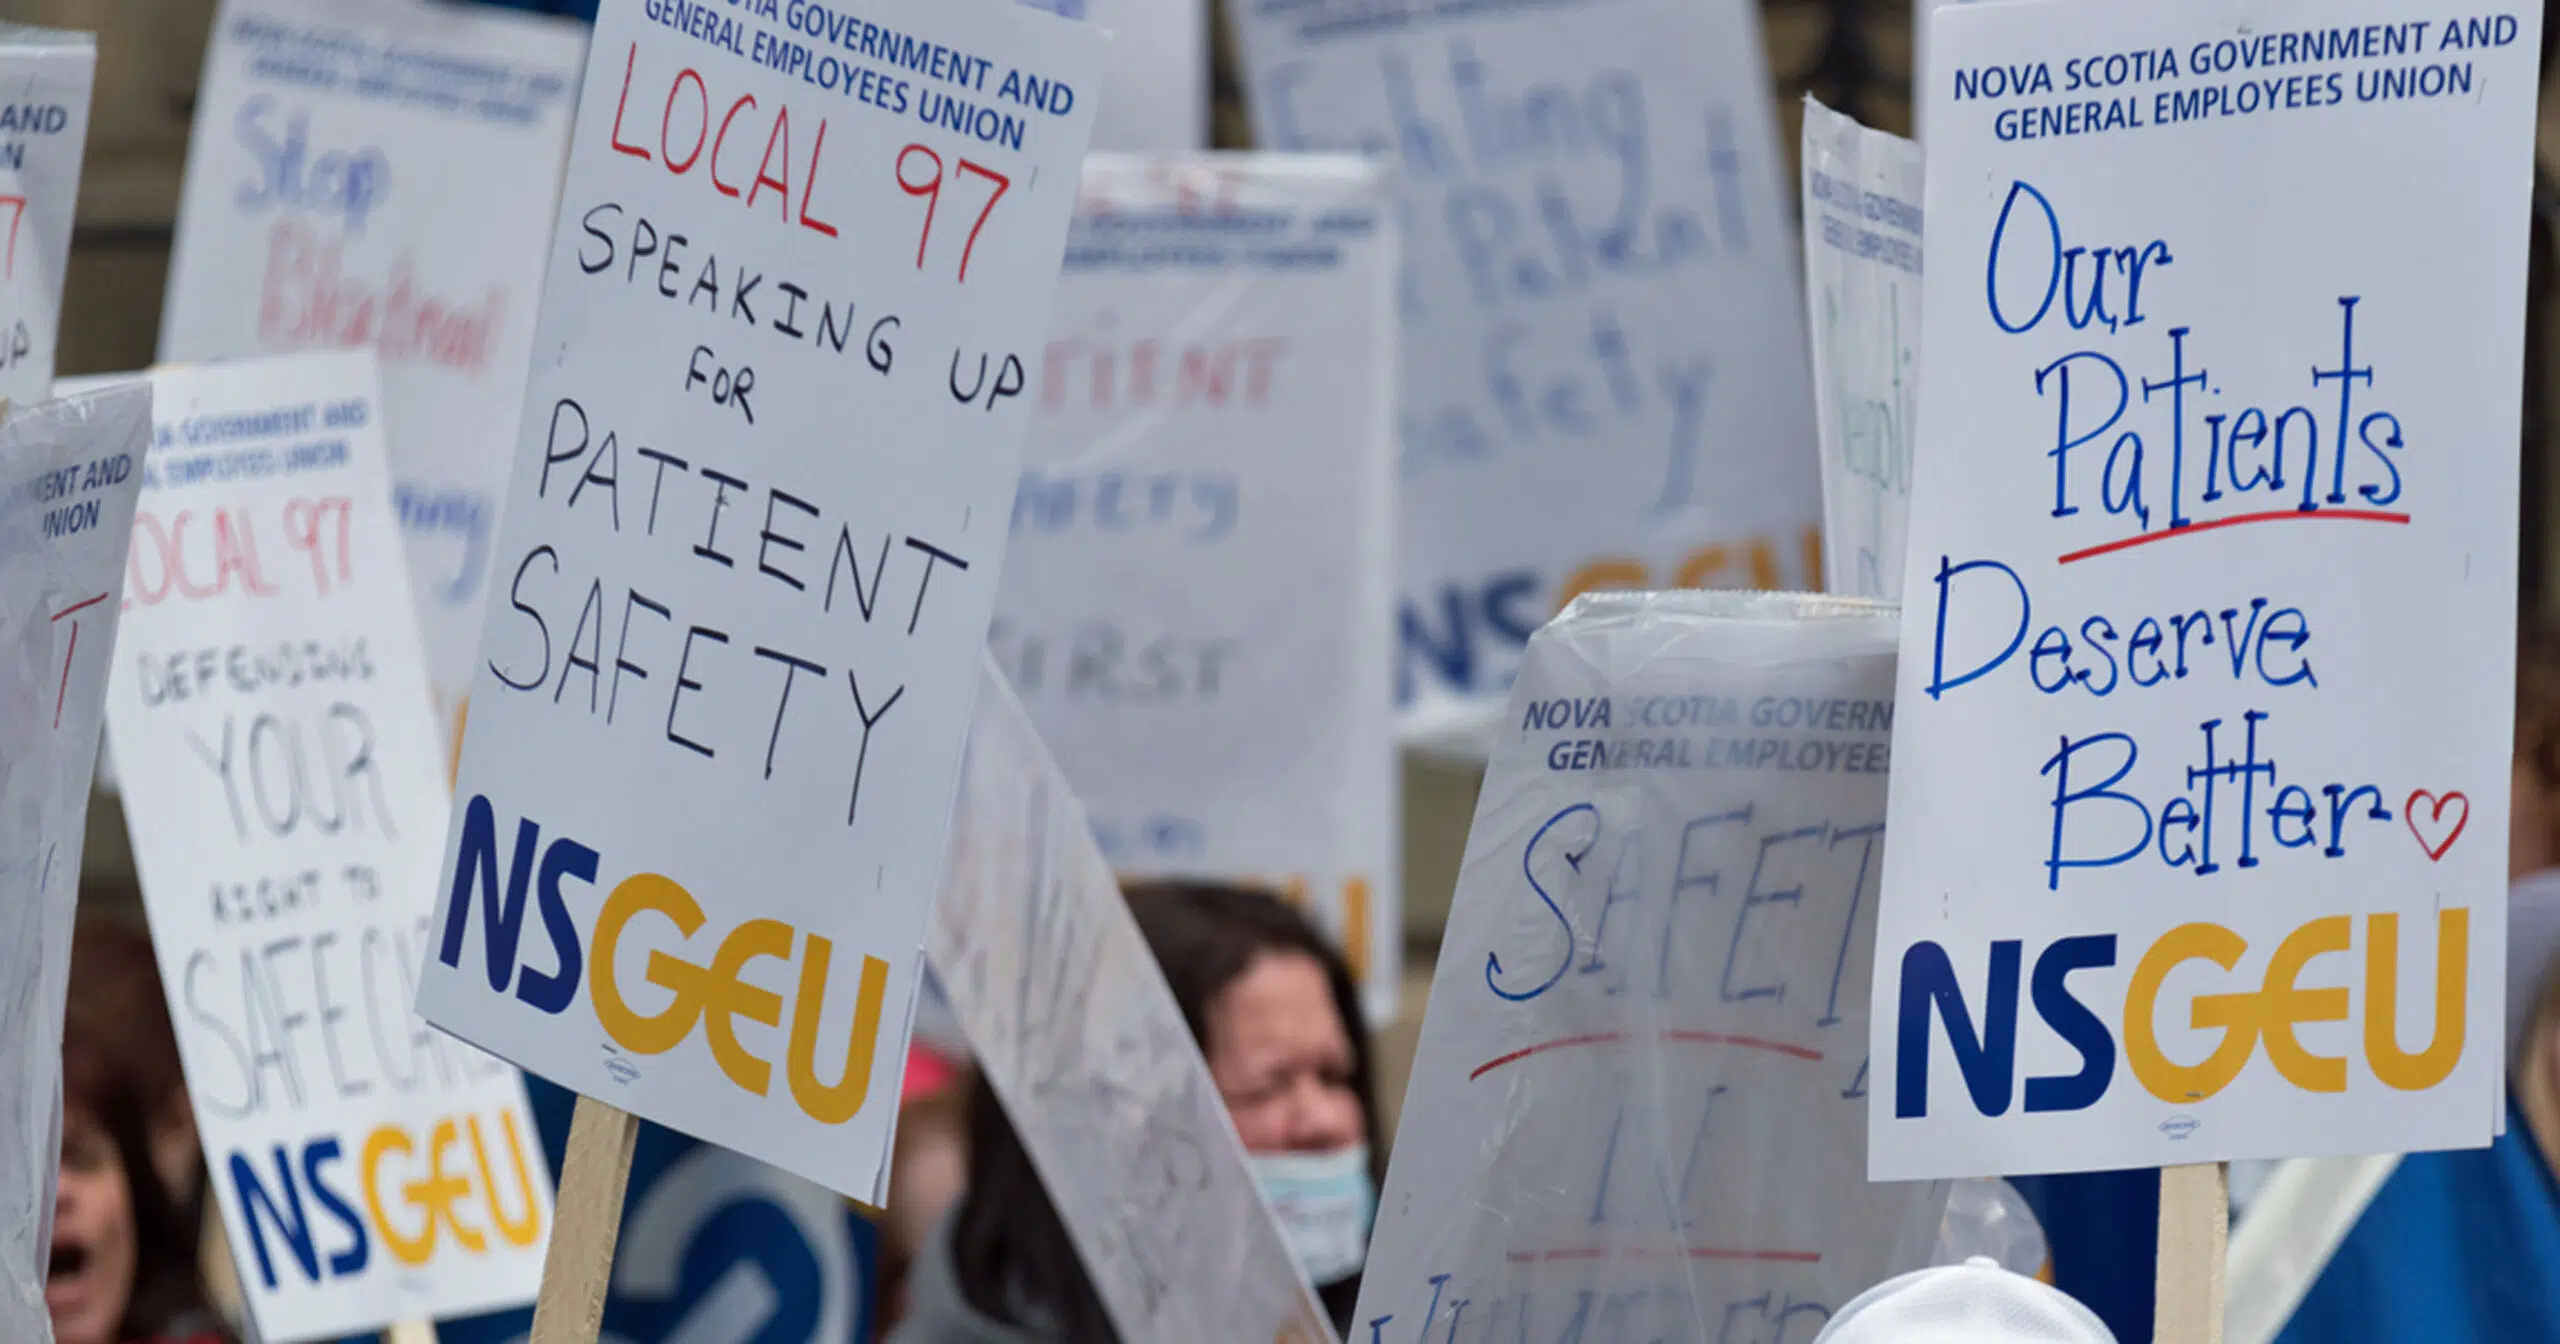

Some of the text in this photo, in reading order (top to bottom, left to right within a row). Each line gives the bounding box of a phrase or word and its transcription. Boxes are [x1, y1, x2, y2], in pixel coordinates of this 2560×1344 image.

[0, 104, 68, 134] AND
[644, 0, 1026, 151] GENERAL EMPLOYEES UNION
[786, 0, 1075, 117] GOVERNMENT AND
[1954, 14, 2518, 101] NOVA SCOTIA GOVERNMENT AND
[1994, 63, 2473, 141] GENERAL EMPLOYEES UNION
[611, 42, 838, 237] LOCAL
[896, 143, 1009, 283] 97
[578, 203, 1025, 411] SPEAKING UP
[1986, 180, 2173, 335] Our
[686, 345, 755, 424] FOR
[2035, 296, 2404, 531] Patients
[81, 452, 133, 493] AND
[540, 398, 969, 636] PATIENT
[120, 506, 280, 612] OCAL
[283, 496, 354, 597] 97
[1924, 554, 2318, 700] Deserve
[489, 545, 904, 826] SAFETY
[988, 614, 1240, 702] IRST
[1522, 698, 1612, 731] NOVA
[1622, 697, 1738, 729] SCOTIA
[184, 702, 399, 845] YOUR
[1547, 740, 1890, 774] GENERAL EMPLOYEE
[2040, 710, 2393, 890] Better
[439, 794, 890, 1124] NSGEU
[1486, 801, 1887, 1098] SAFET
[1895, 906, 2470, 1119] NSGEU
[227, 1110, 541, 1289] NSGEU
